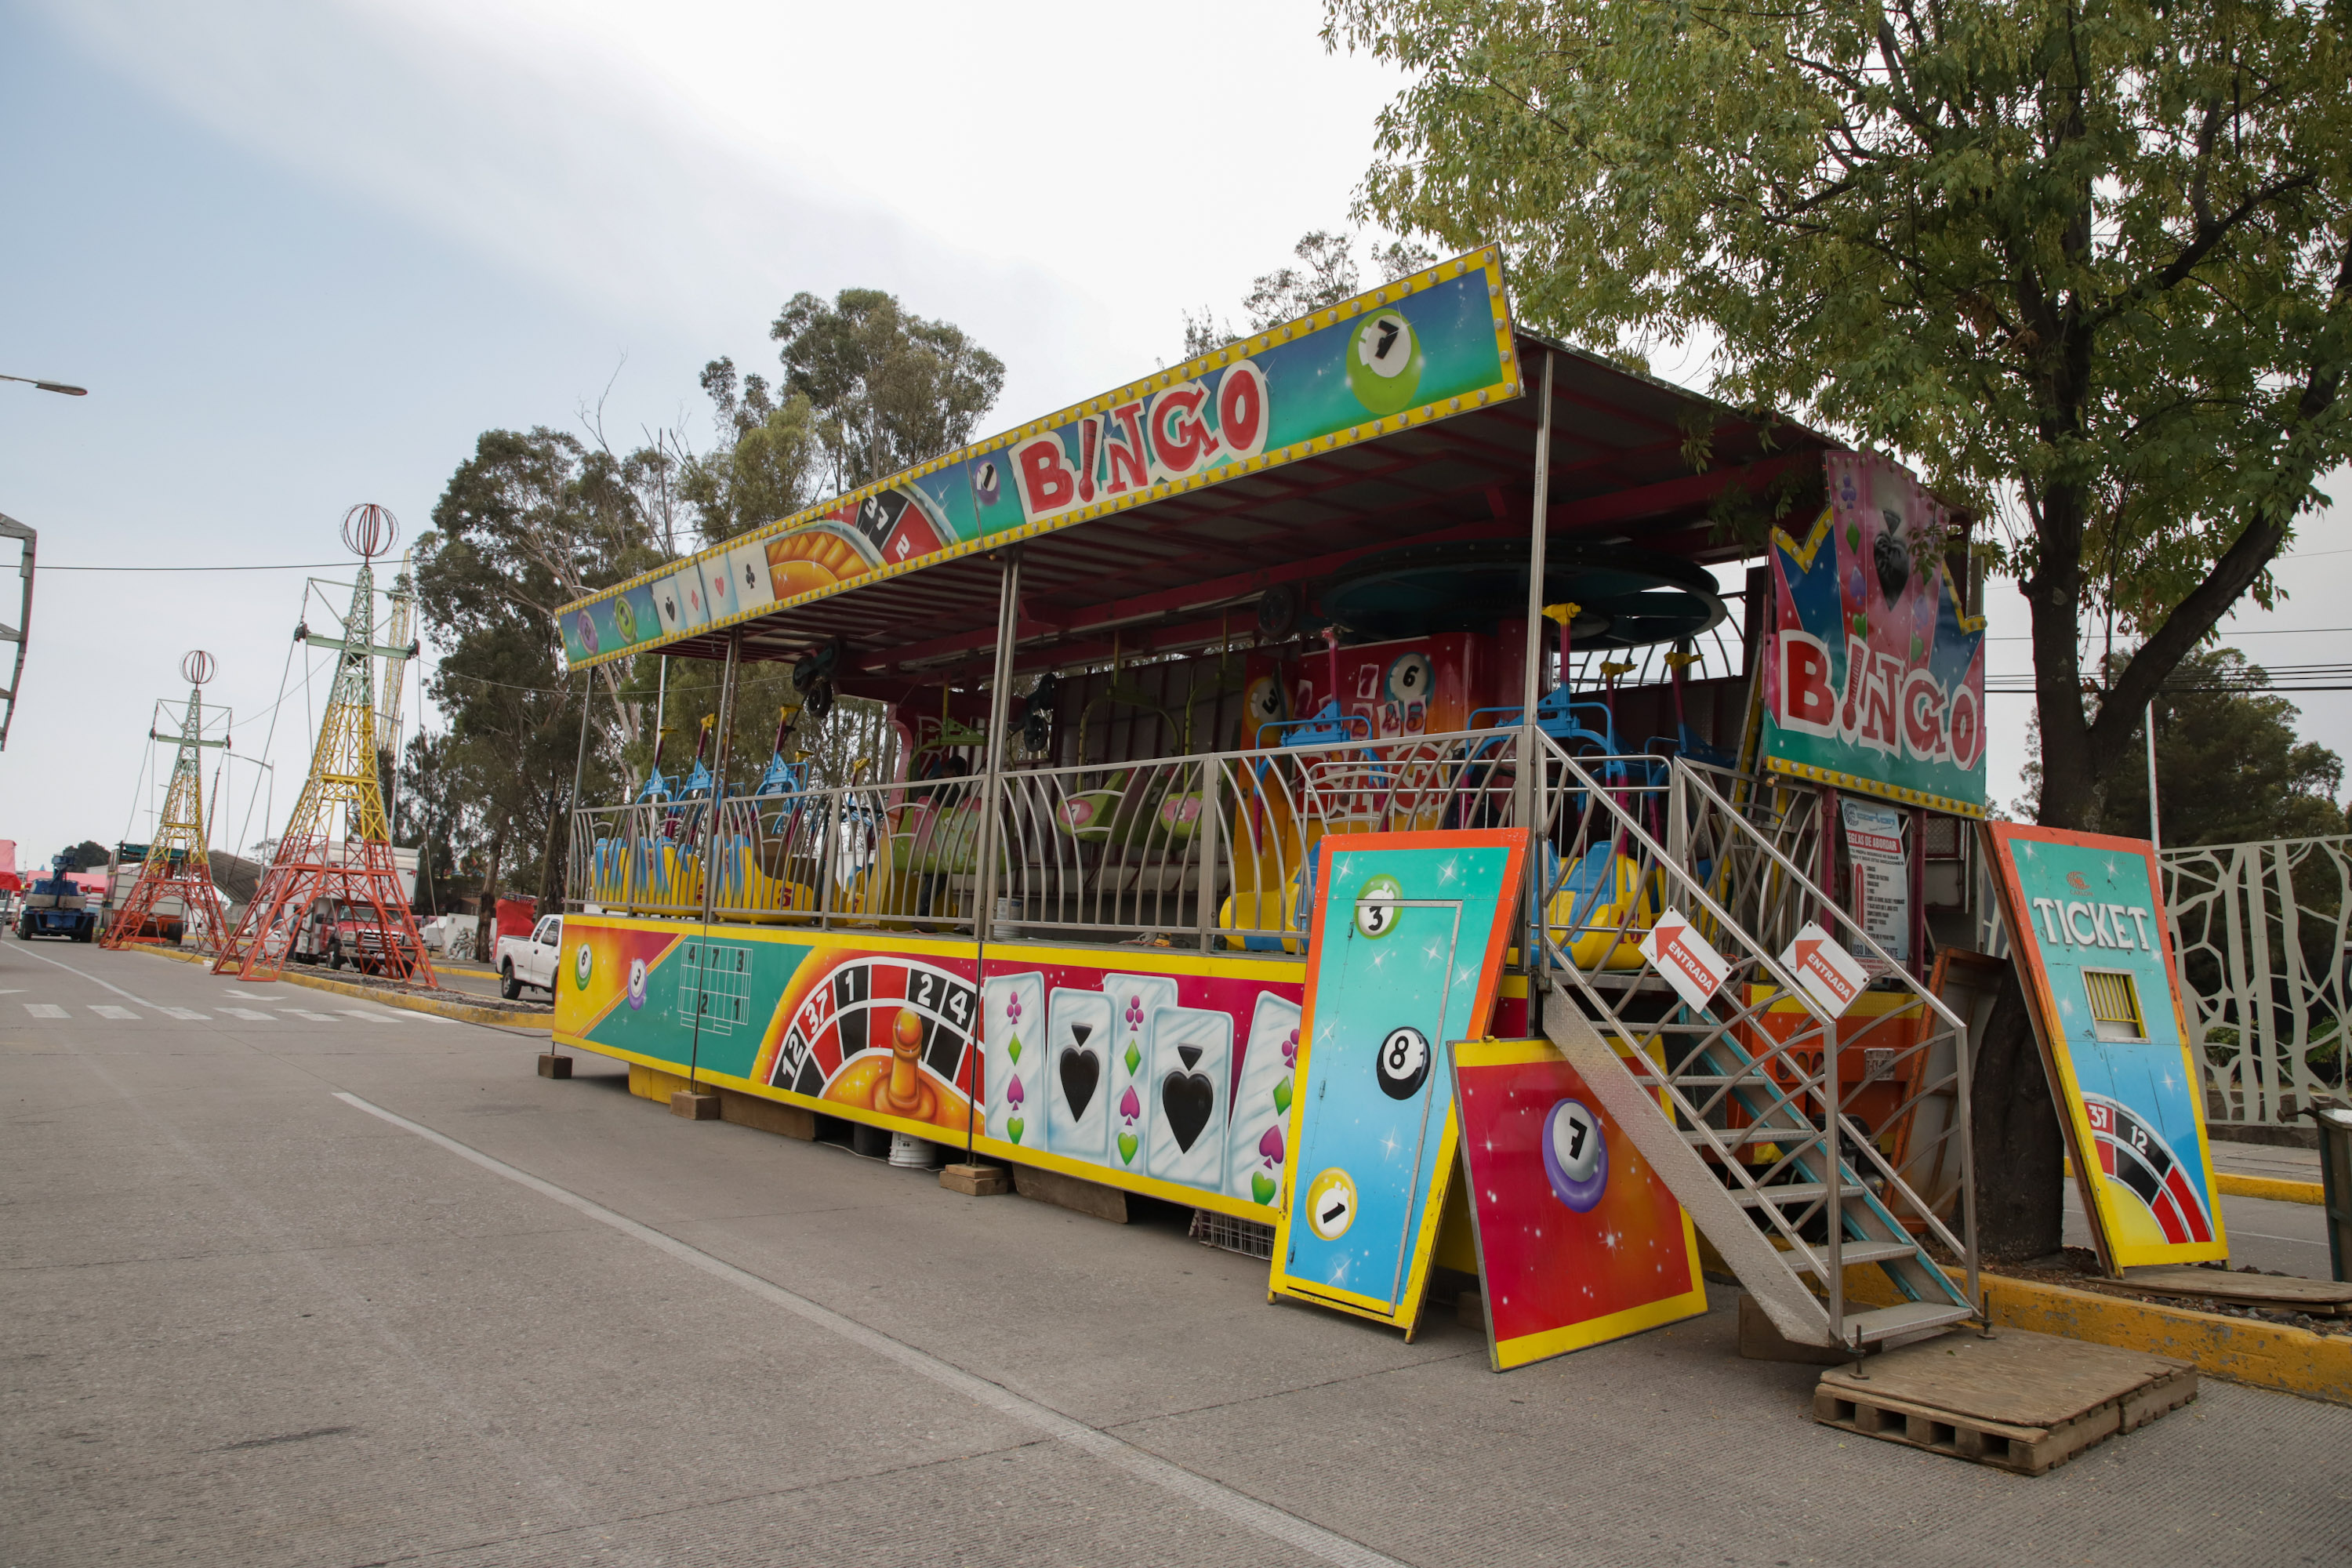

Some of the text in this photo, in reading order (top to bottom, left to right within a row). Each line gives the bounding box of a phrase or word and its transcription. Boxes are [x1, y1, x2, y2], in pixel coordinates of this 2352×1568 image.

[1014, 365, 1265, 517] BINGO
[1403, 665, 1420, 687] 6
[1783, 633, 1976, 768] BINGO
[1865, 836, 1872, 847] DE
[1872, 837, 1897, 851] ABORDAR
[2032, 896, 2151, 952] TICKET
[688, 946, 745, 972] 4 7 3
[1667, 940, 1714, 993] ENTRADA
[1806, 952, 1851, 1000] ENTRADA
[700, 993, 708, 1014] 2
[805, 988, 829, 1034] 37
[845, 970, 968, 1025] 1 2 4
[781, 1033, 804, 1078] 12
[1388, 1035, 1410, 1071] 8
[2089, 1105, 2109, 1129] 37
[2130, 1124, 2149, 1156] 12
[1321, 1200, 1346, 1224] 1
